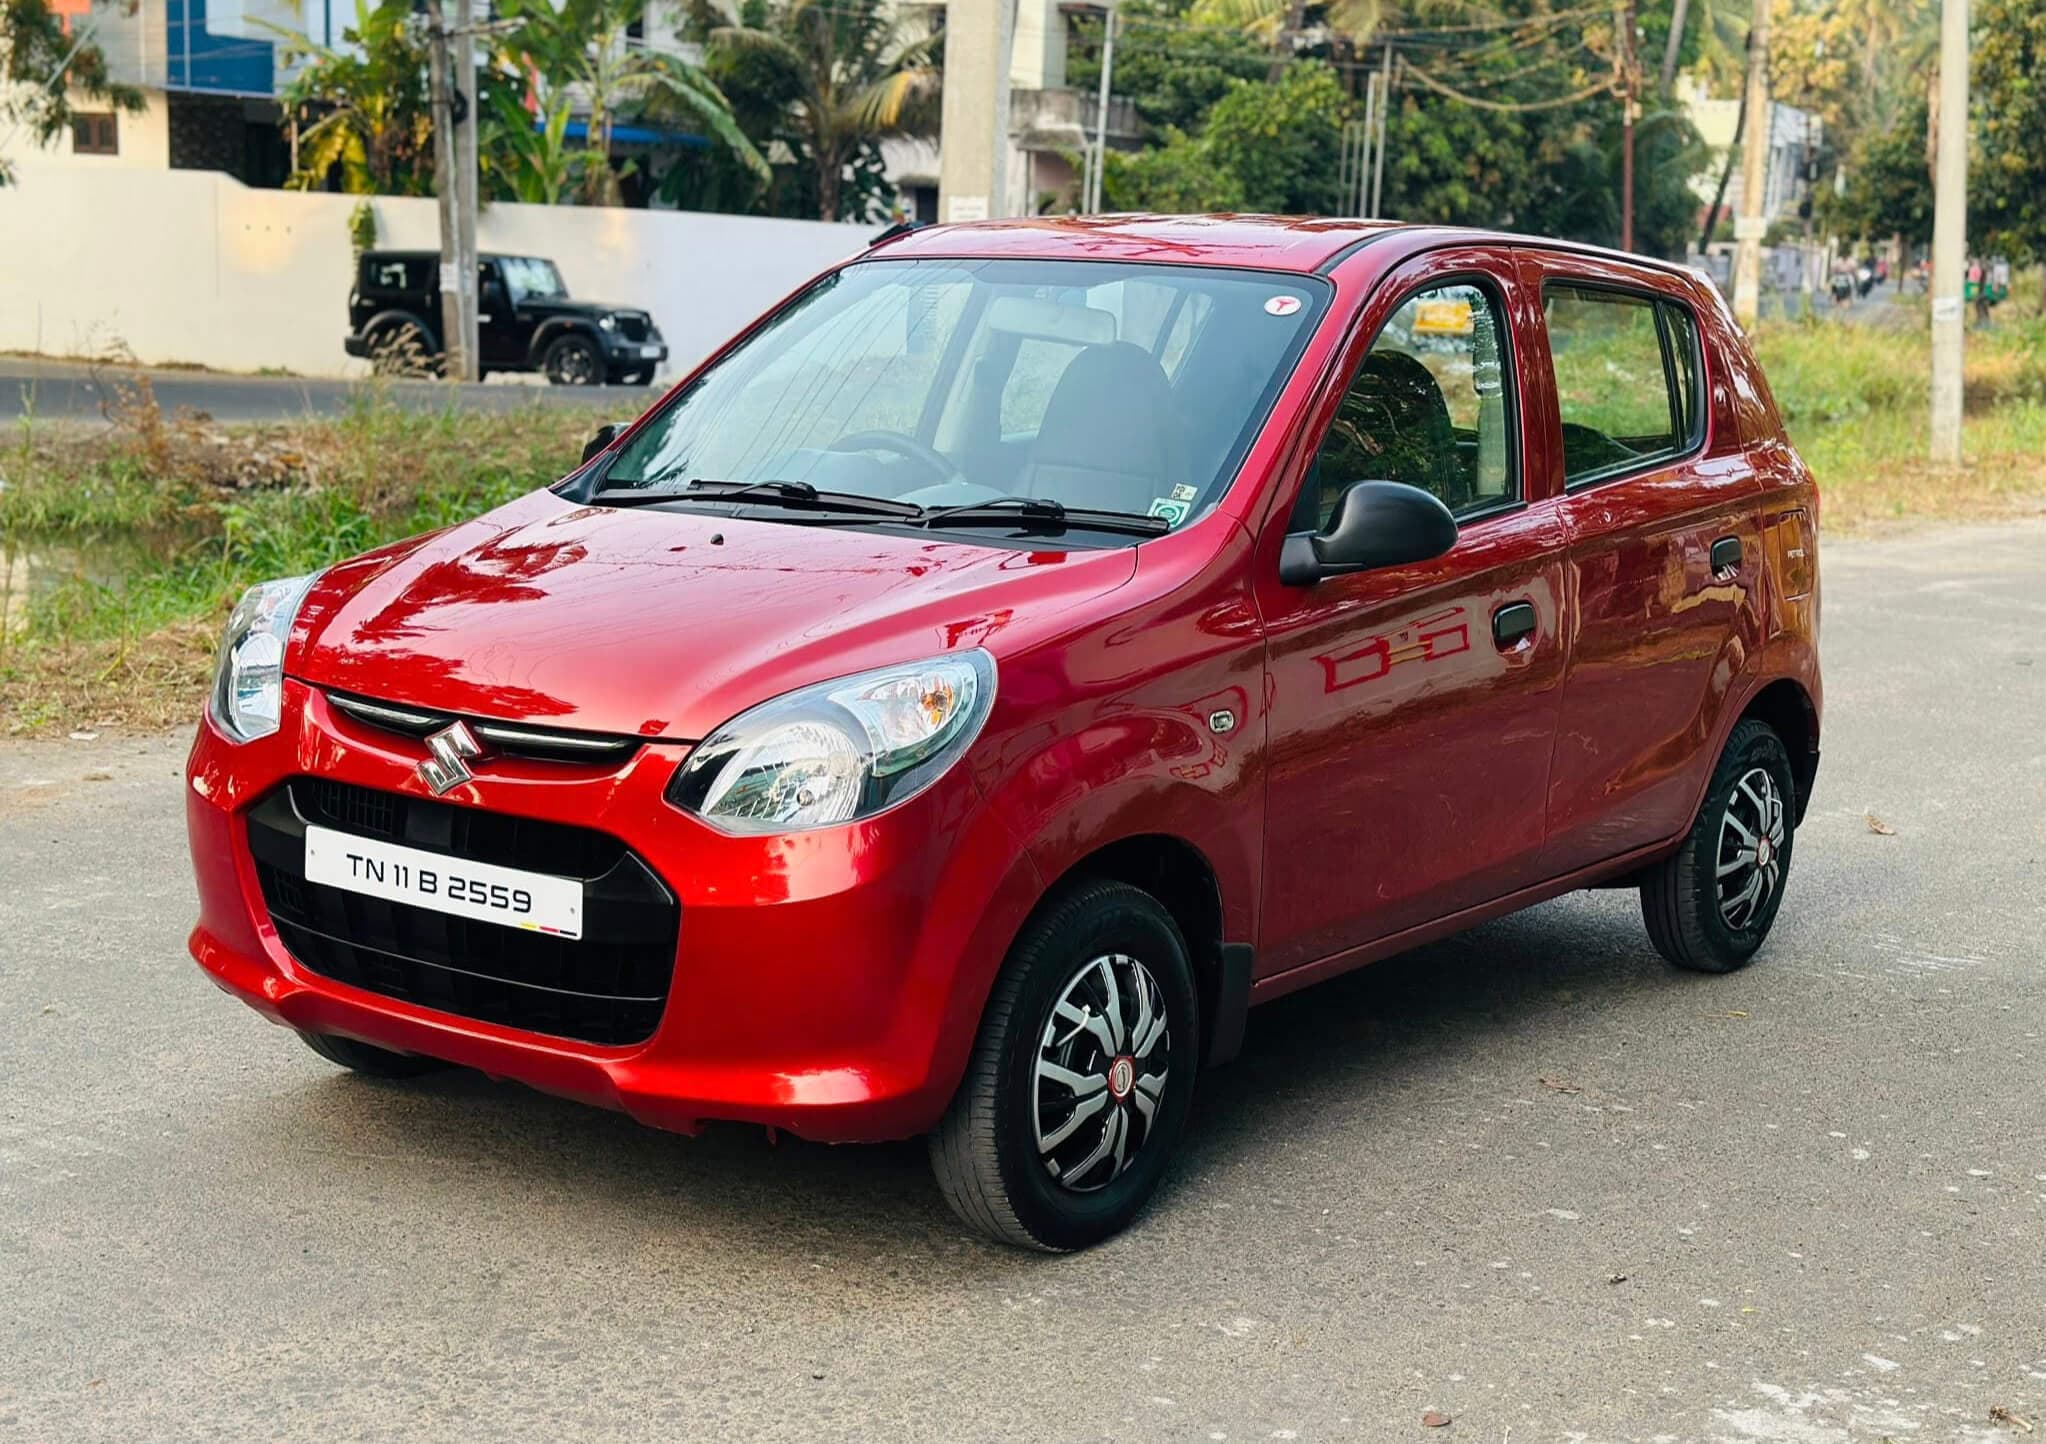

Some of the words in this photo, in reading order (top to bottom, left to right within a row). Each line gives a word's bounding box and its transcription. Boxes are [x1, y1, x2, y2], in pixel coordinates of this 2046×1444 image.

[346, 853, 385, 883] TN
[393, 864, 409, 889] 11
[419, 869, 438, 894] B
[447, 875, 532, 914] 2559
